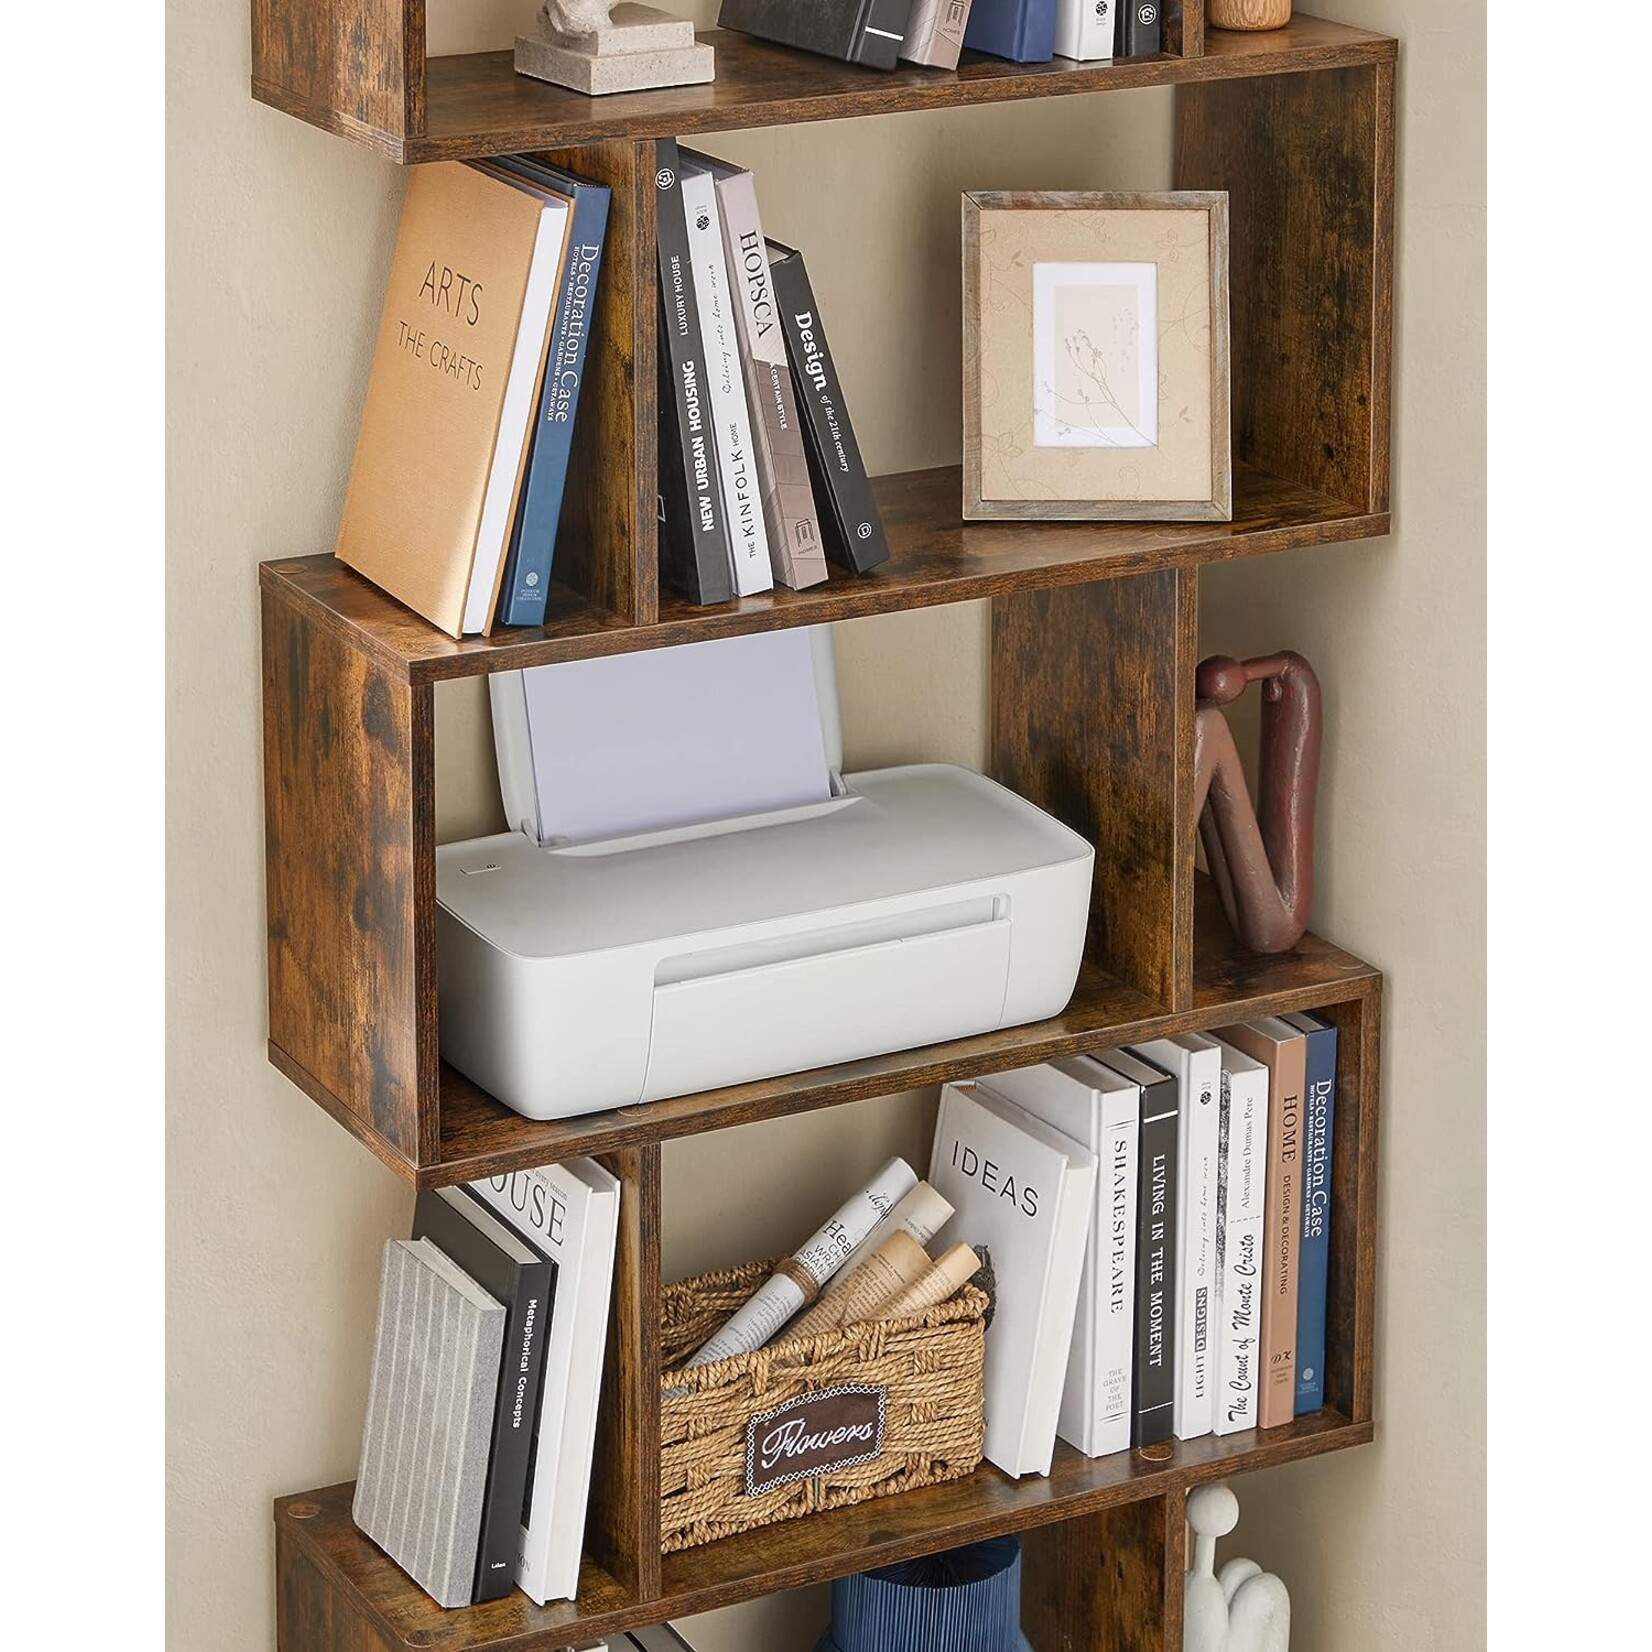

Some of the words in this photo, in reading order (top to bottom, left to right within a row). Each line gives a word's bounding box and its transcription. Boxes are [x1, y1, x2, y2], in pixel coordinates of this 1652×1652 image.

[570, 246, 580, 276] HOTELS
[671, 255, 682, 292] HOUSE
[740, 230, 774, 338] HOPSCA
[419, 260, 484, 326] ARTS
[560, 282, 574, 335] RESTAURANTS
[564, 244, 600, 365] Decoration
[676, 292, 688, 336] LUXURY
[398, 321, 426, 358] THE
[429, 341, 484, 391] CRAFTS
[554, 341, 565, 376] GARDENS
[794, 311, 827, 391] Design
[548, 382, 559, 421] GETAWAYS
[555, 371, 578, 422] Case
[682, 360, 702, 432] HOUSING
[770, 368, 782, 404] CERTAIN
[777, 404, 788, 430] STYLE
[820, 395, 832, 404] of
[824, 407, 836, 421] the
[728, 423, 738, 446] HOME
[829, 421, 842, 440] 21th
[693, 435, 710, 490] URBAN
[836, 440, 850, 472] century
[700, 496, 715, 532] NEW
[733, 450, 755, 538] KINFOLK
[1244, 1096, 1253, 1120] Pere
[1283, 1094, 1298, 1163] HOME
[1243, 1122, 1253, 1155] Dumas
[1311, 1079, 1332, 1187] Decoration
[952, 1140, 1039, 1217] IDEAS
[1152, 1154, 1165, 1216] LIVING
[1242, 1156, 1253, 1208] Alexandre
[1282, 1175, 1291, 1214] DESIGN
[1110, 1140, 1127, 1314] SHAKESPEARE
[1152, 1222, 1164, 1240] IN
[1282, 1216, 1290, 1225] &
[1311, 1191, 1327, 1237] Case
[1151, 1247, 1163, 1285] THE
[1233, 1234, 1256, 1276] Cristo
[1280, 1226, 1290, 1295] DECORATING
[1150, 1292, 1163, 1366] MOMENT
[1195, 1287, 1207, 1352] DESIGNS
[1232, 1283, 1252, 1330] Monte
[520, 1300, 537, 1372] Metaphorical
[1232, 1339, 1256, 1350] of
[1196, 1355, 1204, 1398] LIGHT
[1228, 1354, 1251, 1391] Count
[512, 1376, 528, 1428] Concepts
[1228, 1397, 1248, 1422] The
[762, 1417, 874, 1469] Flowers
